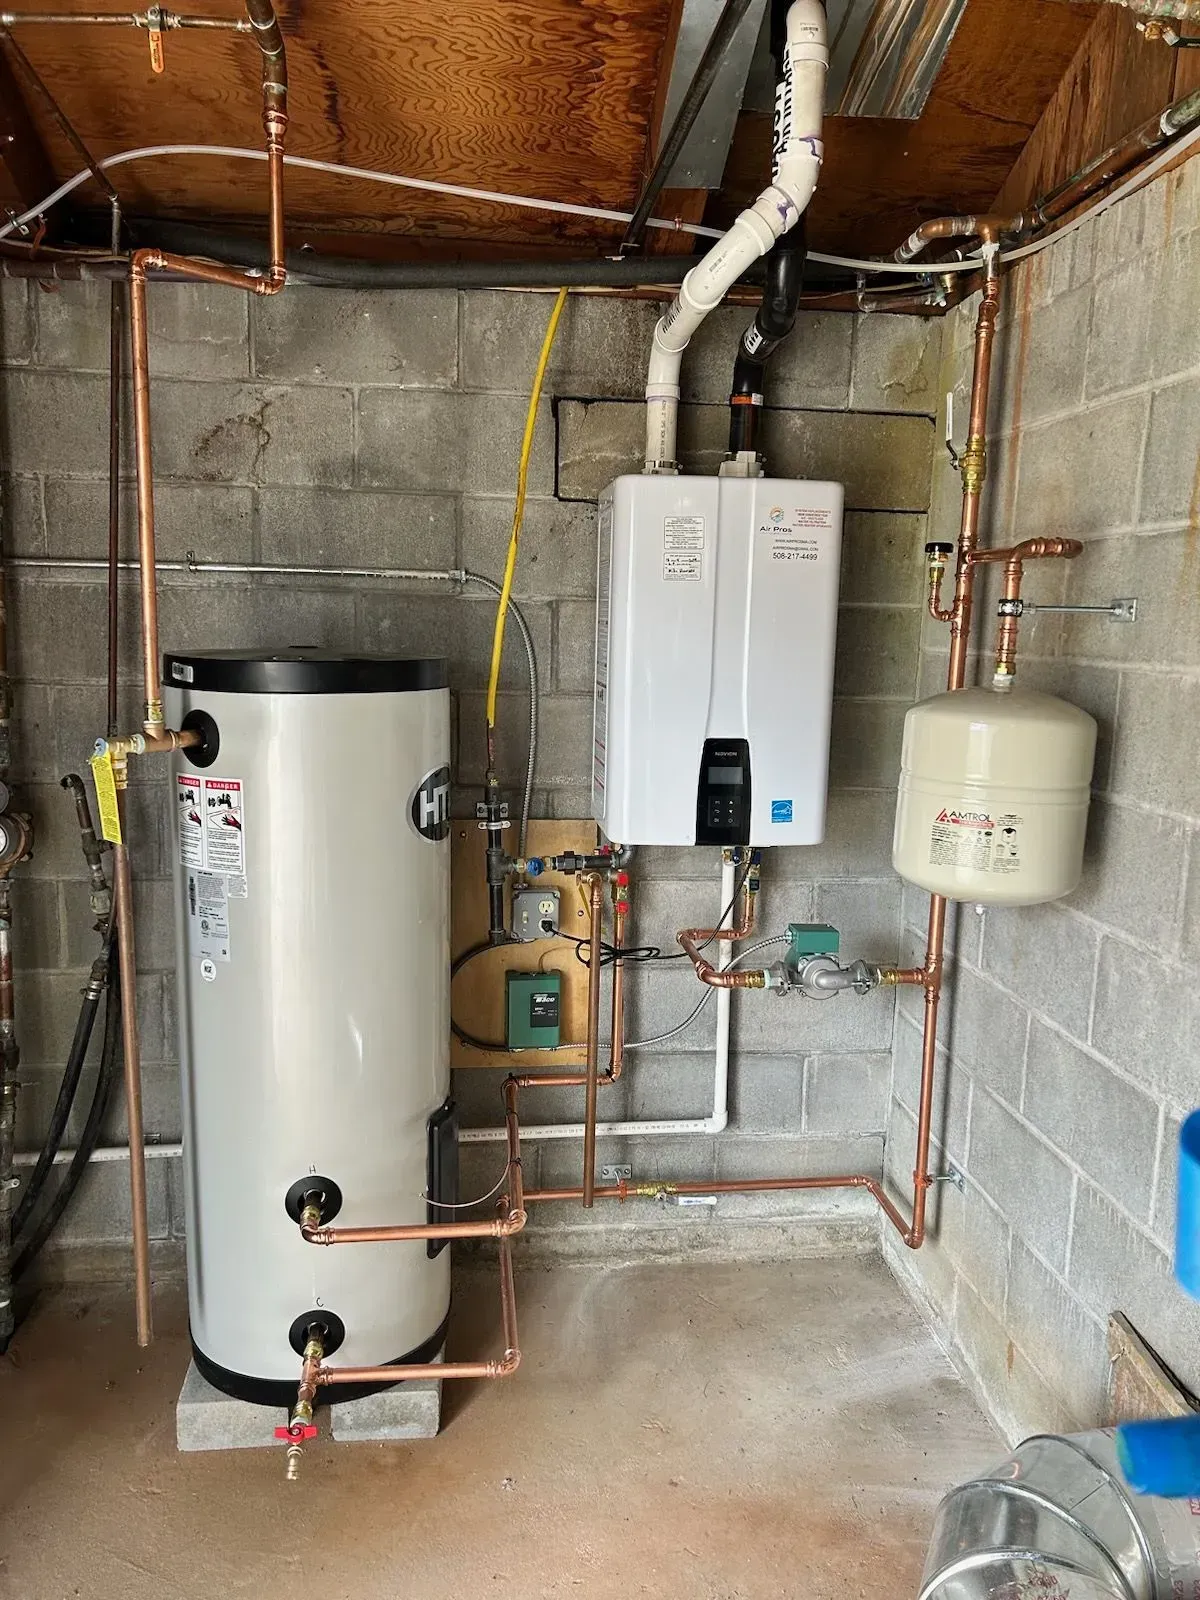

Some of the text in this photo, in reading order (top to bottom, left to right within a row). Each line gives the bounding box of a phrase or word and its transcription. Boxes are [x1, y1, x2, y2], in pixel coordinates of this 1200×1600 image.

[773, 552, 818, 561] 508-217-4499
[212, 782, 239, 790] DANGER
[949, 810, 992, 823] AMTROL
[315, 1297, 325, 1308] C
